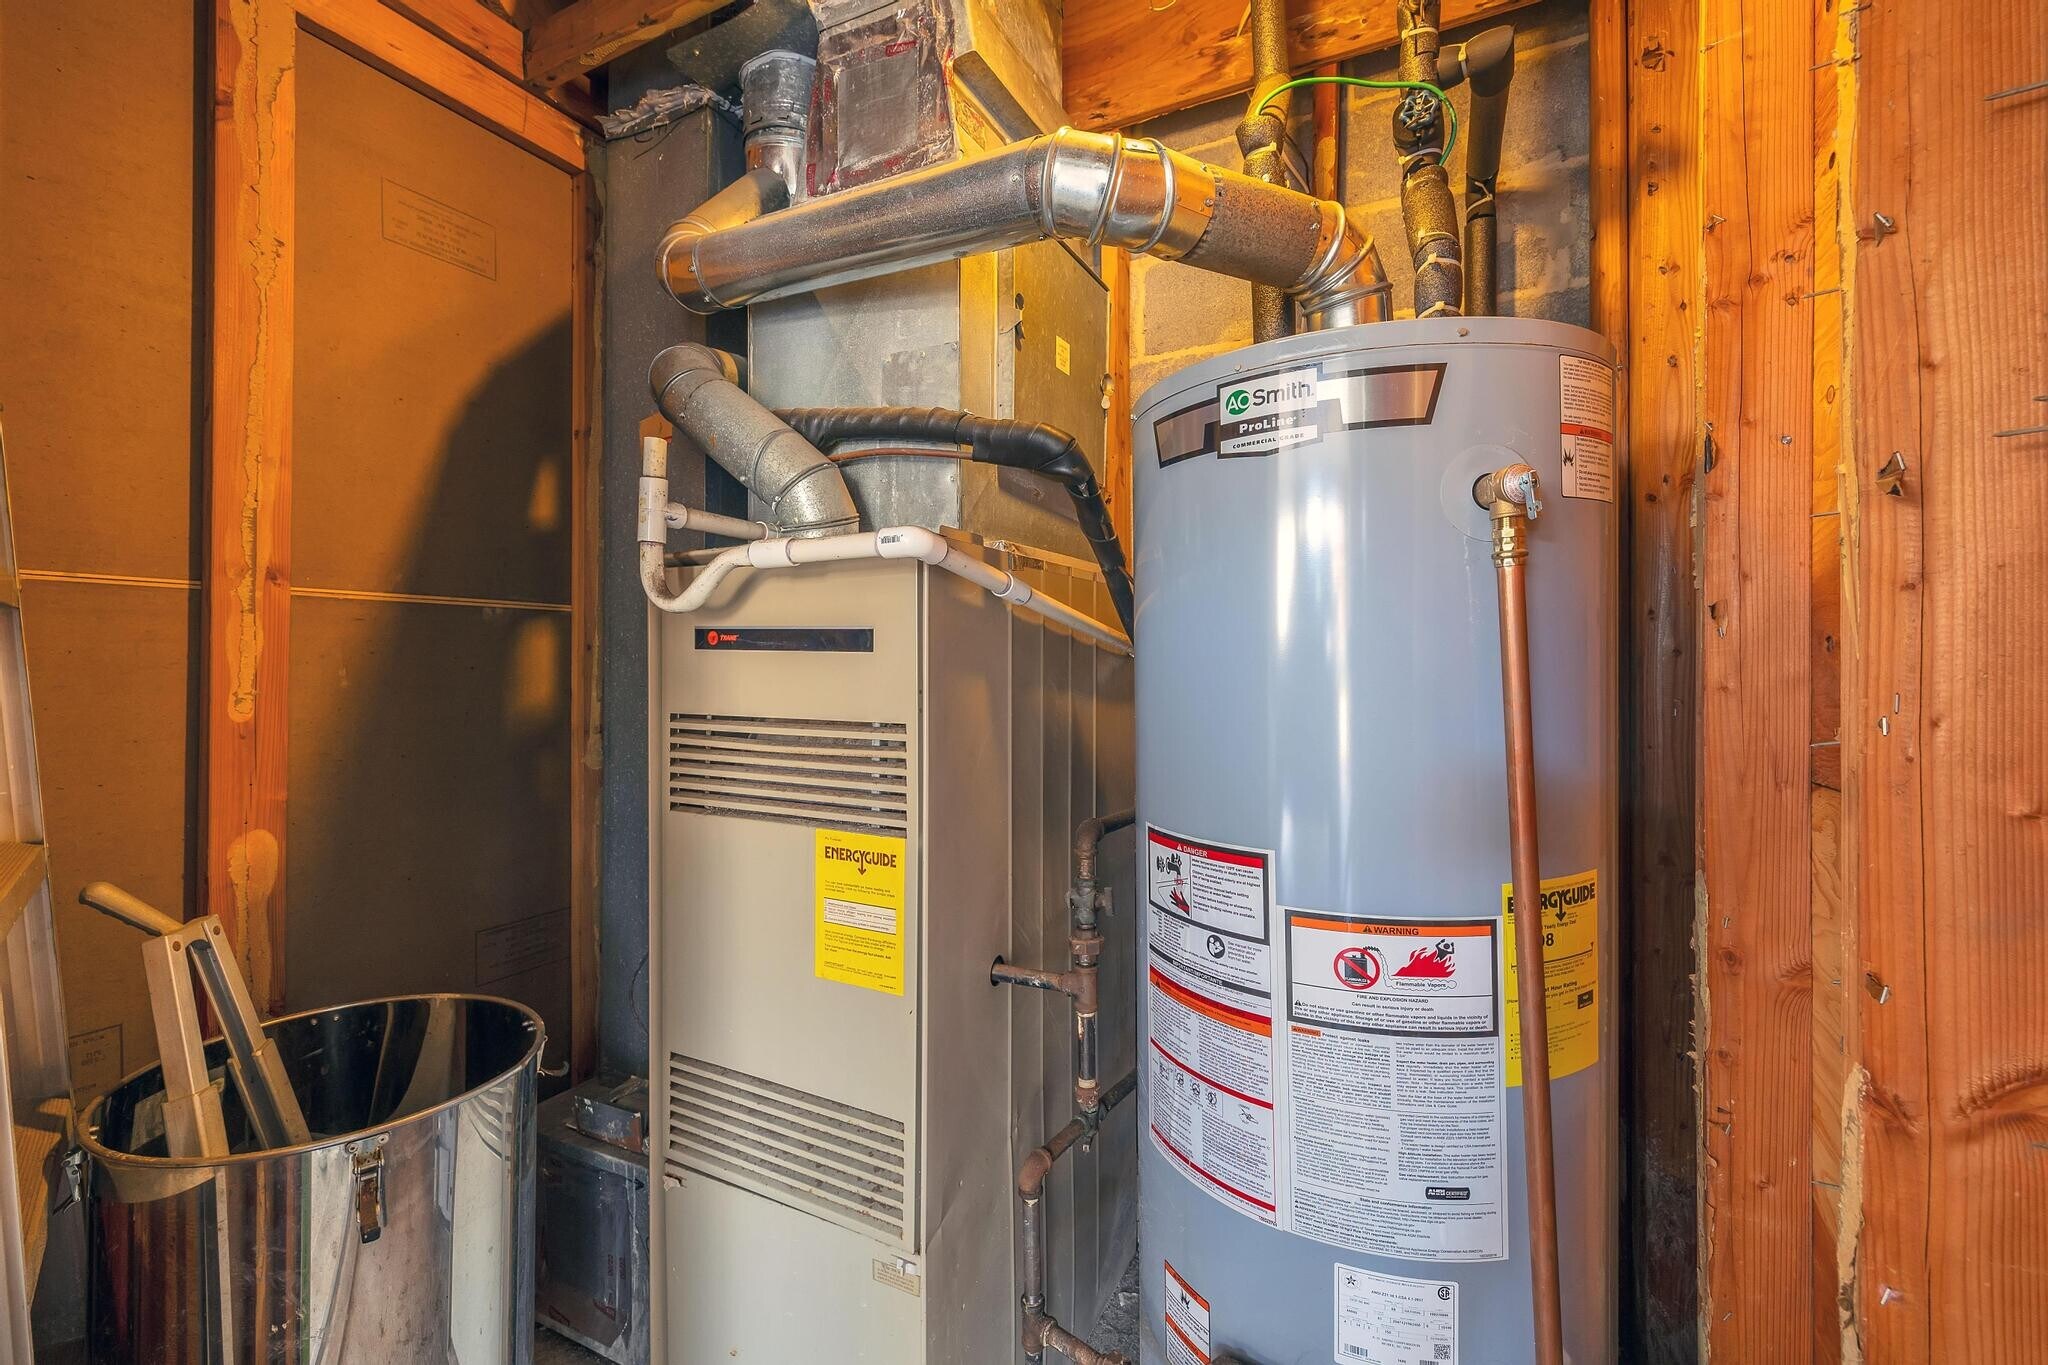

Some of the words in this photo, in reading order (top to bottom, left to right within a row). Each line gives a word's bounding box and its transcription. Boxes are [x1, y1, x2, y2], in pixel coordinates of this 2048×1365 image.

[1239, 416, 1294, 434] ProLine
[1232, 437, 1277, 449] COMMERCIAL
[1280, 432, 1305, 441] GRADE
[825, 846, 897, 869] ENERGYGUIDE
[1183, 845, 1208, 859] DANGER
[1507, 882, 1596, 914] ERGYGUIDE
[1373, 926, 1419, 936] WARNING
